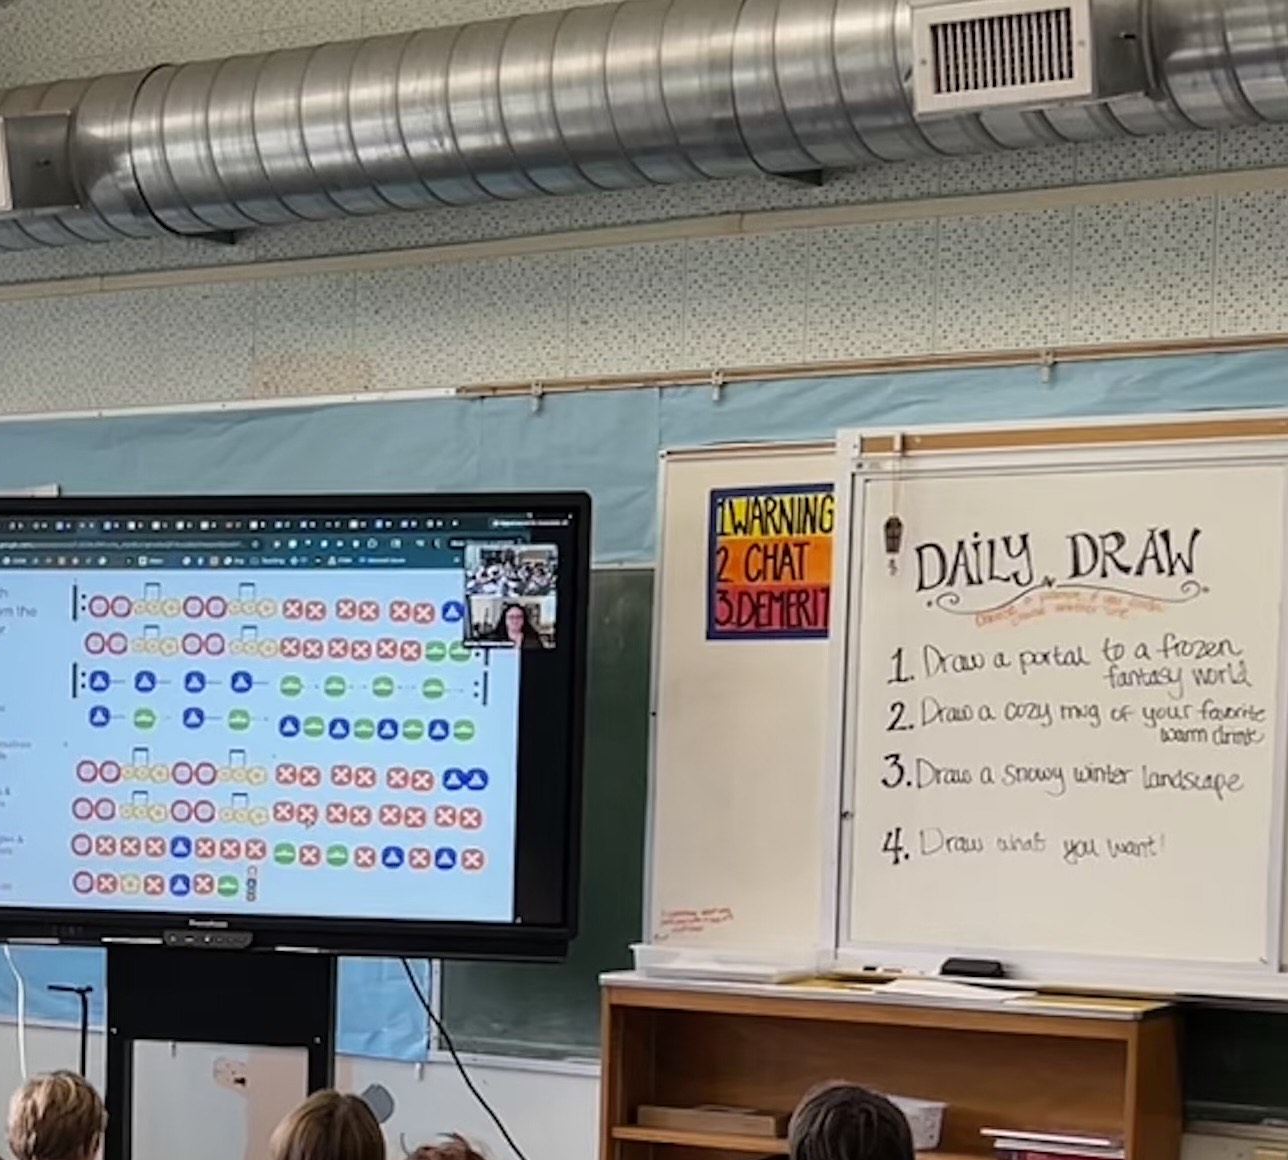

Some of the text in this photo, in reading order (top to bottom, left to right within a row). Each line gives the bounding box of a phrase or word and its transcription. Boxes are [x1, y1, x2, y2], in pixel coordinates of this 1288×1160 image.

[716, 541, 810, 583] 2 CHAT
[914, 527, 1201, 592] DAILY DRAW
[16, 604, 38, 618] the
[887, 632, 1243, 684] 1. Draw a portal to a frozen
[1103, 659, 1254, 700] fantasy world
[886, 695, 1266, 731] 2. Draw a cozy mug of your favorite
[1160, 725, 1265, 746] warm drink
[915, 757, 973, 789] Draw
[980, 766, 995, 785] a
[1073, 763, 1133, 785] winter
[1142, 765, 1244, 801] landscape
[881, 827, 910, 865] 4.
[919, 826, 984, 855] Draw
[996, 831, 1046, 852] what
[1063, 837, 1099, 865] you
